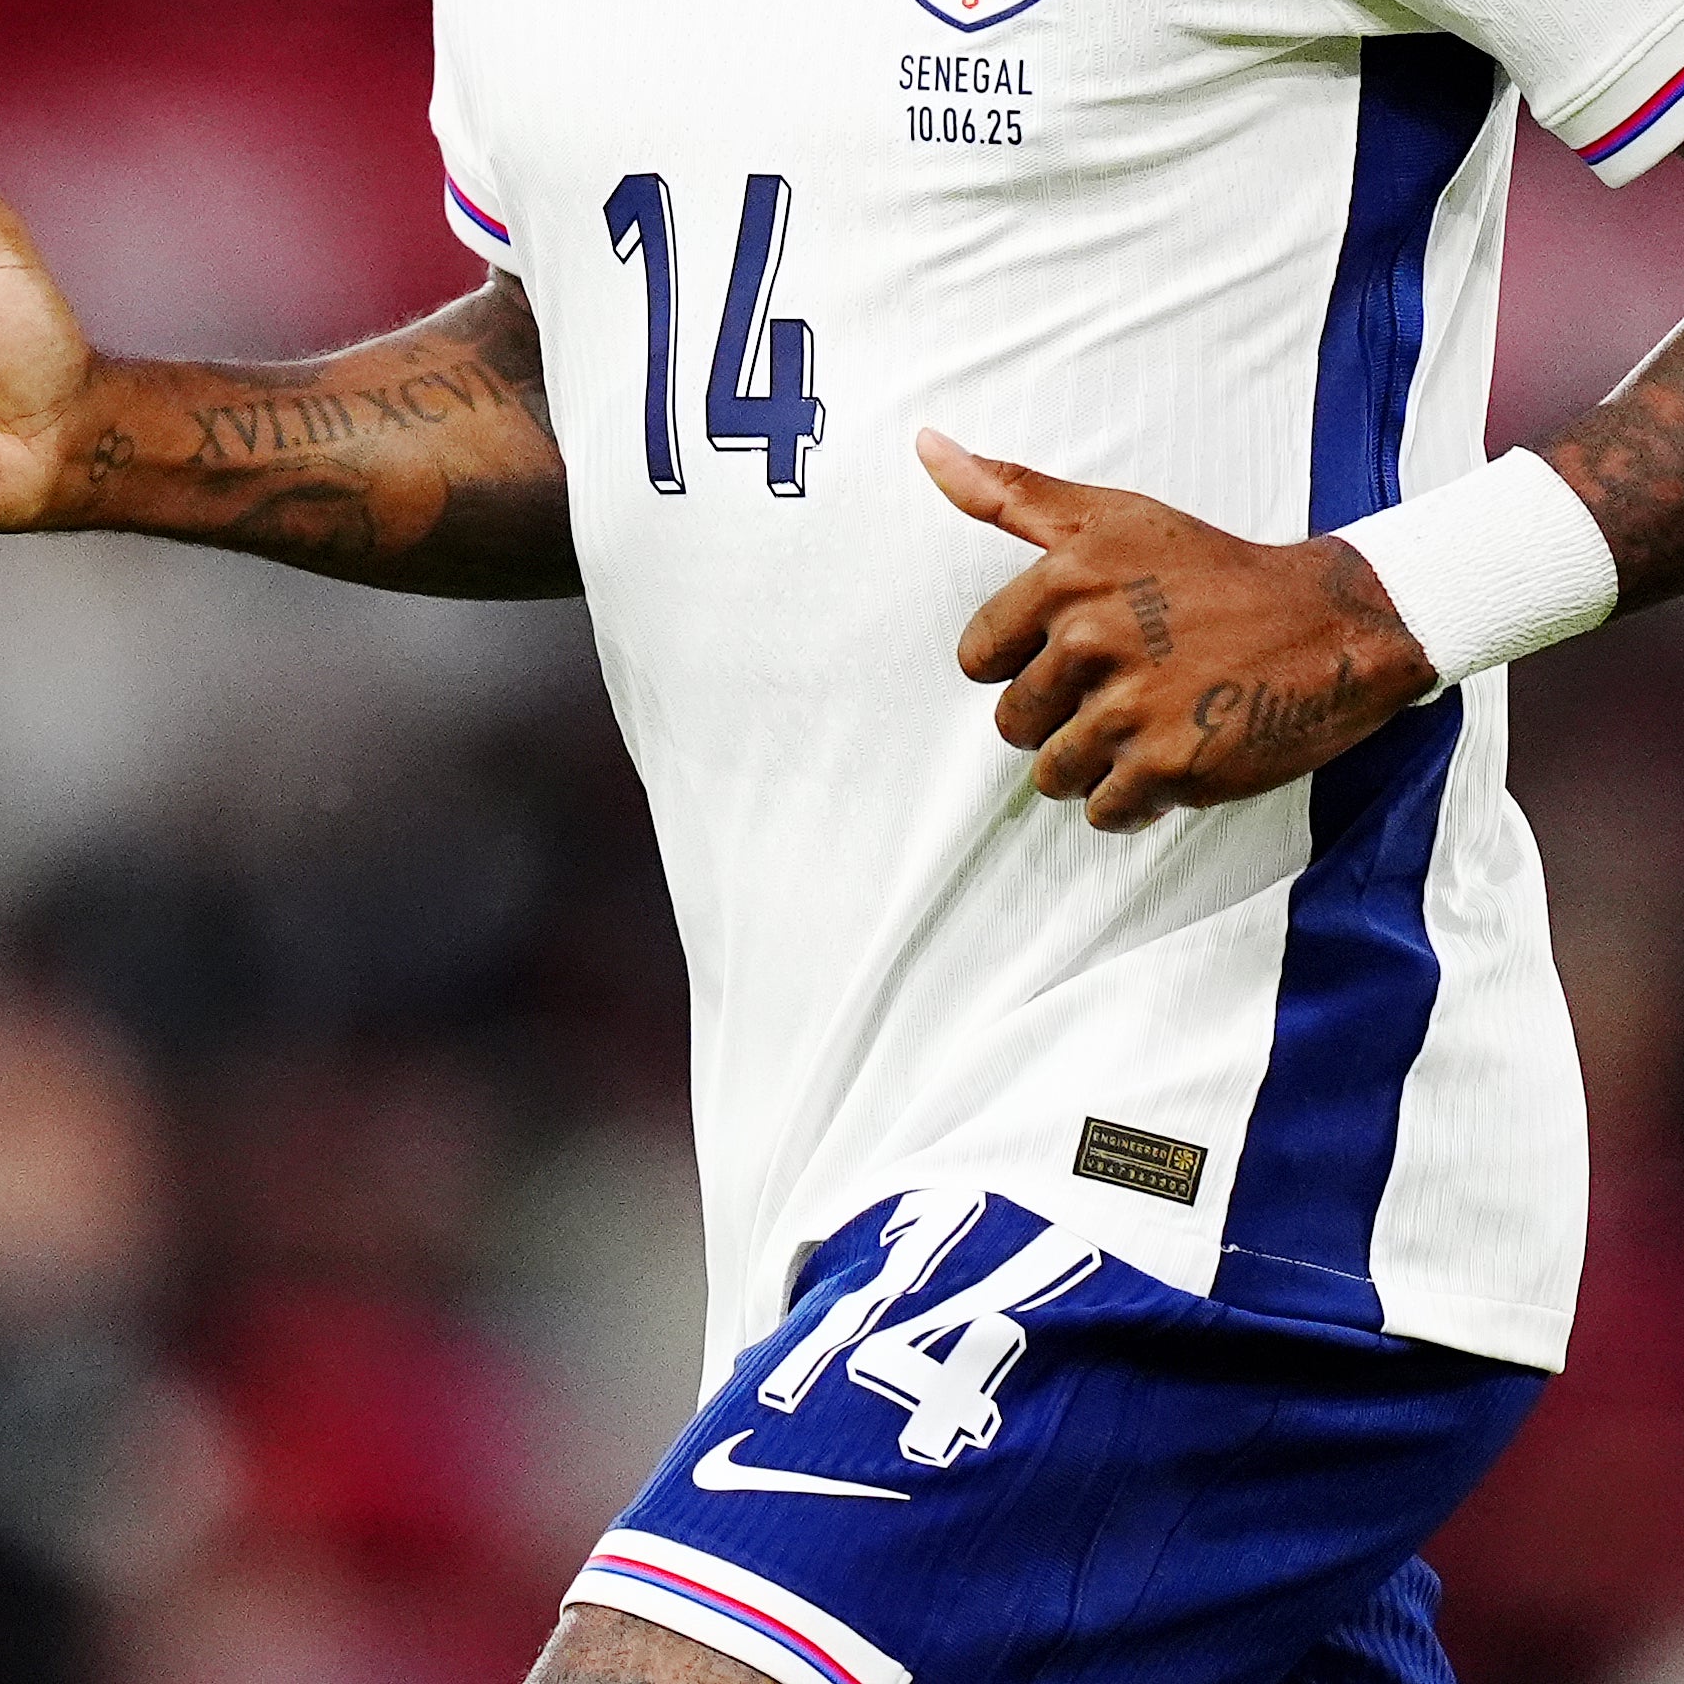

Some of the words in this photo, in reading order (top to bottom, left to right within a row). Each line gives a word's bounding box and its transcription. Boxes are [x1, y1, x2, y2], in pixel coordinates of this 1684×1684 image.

[899, 54, 1033, 95] SENEGAL
[906, 106, 1023, 146] 10.06.25
[602, 172, 826, 498] 14
[1092, 1130, 1168, 1159] ENGINEERED
[757, 1188, 1103, 1469] 14
